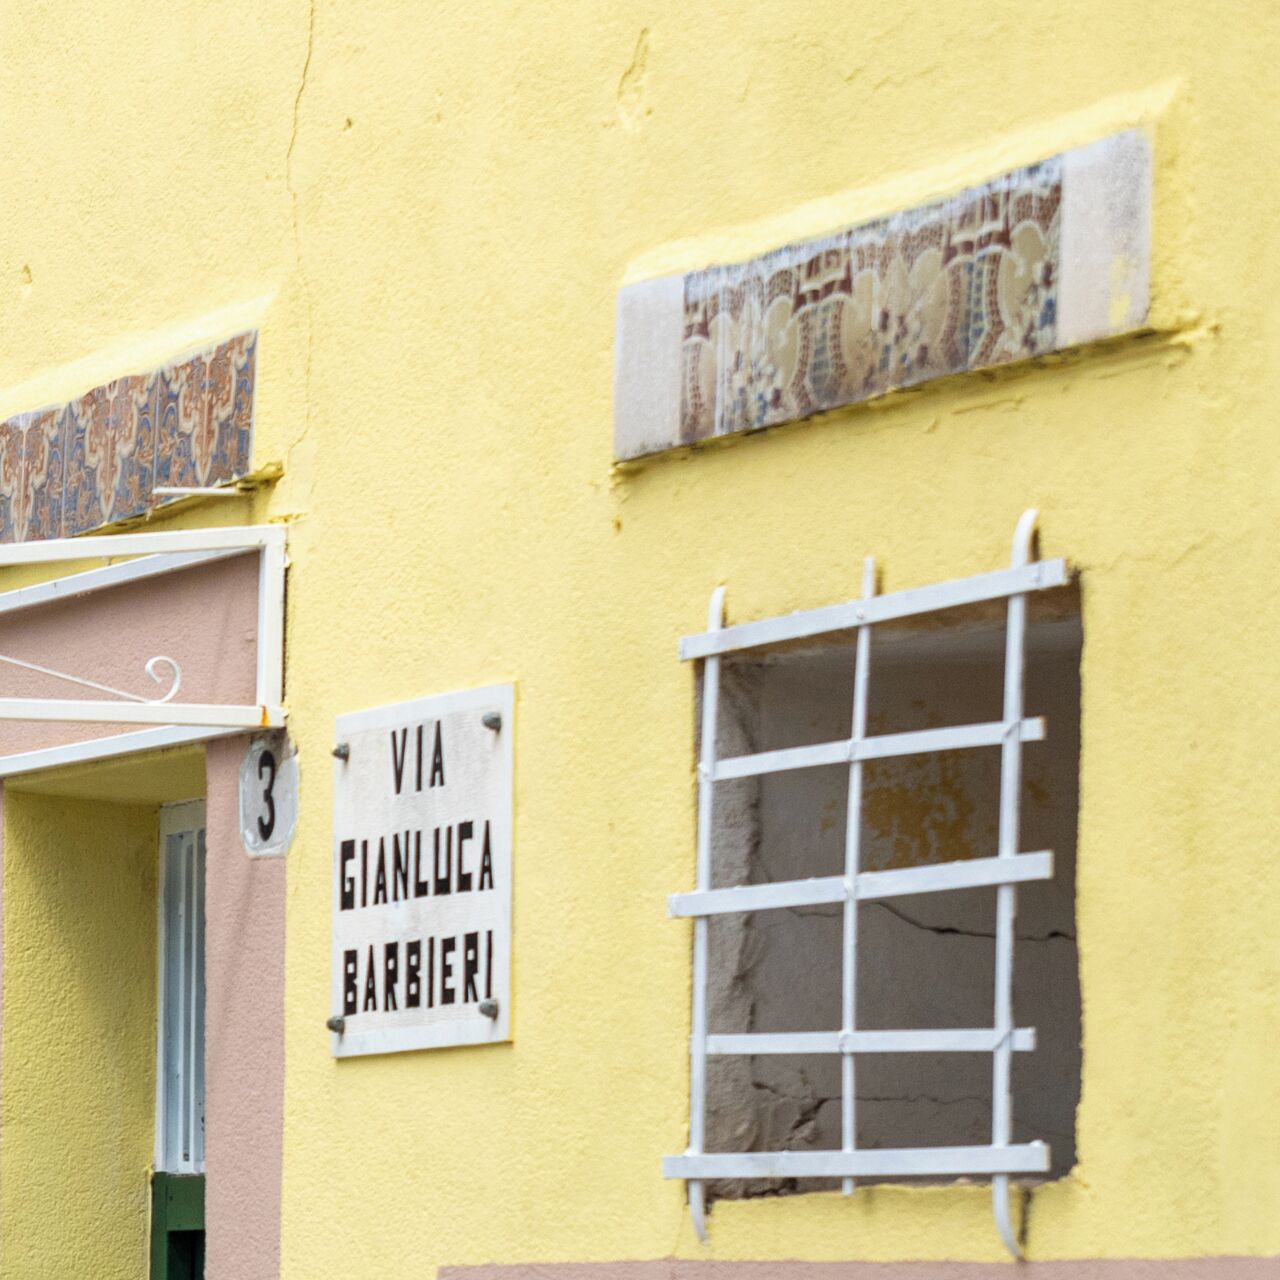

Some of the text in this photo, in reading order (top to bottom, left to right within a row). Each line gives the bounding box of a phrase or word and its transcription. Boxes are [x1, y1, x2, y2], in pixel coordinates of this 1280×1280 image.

[258, 750, 275, 841] 3
[391, 720, 444, 795] VIA
[340, 820, 494, 911] GIANLUCA
[343, 930, 493, 1016] BARBIERI
